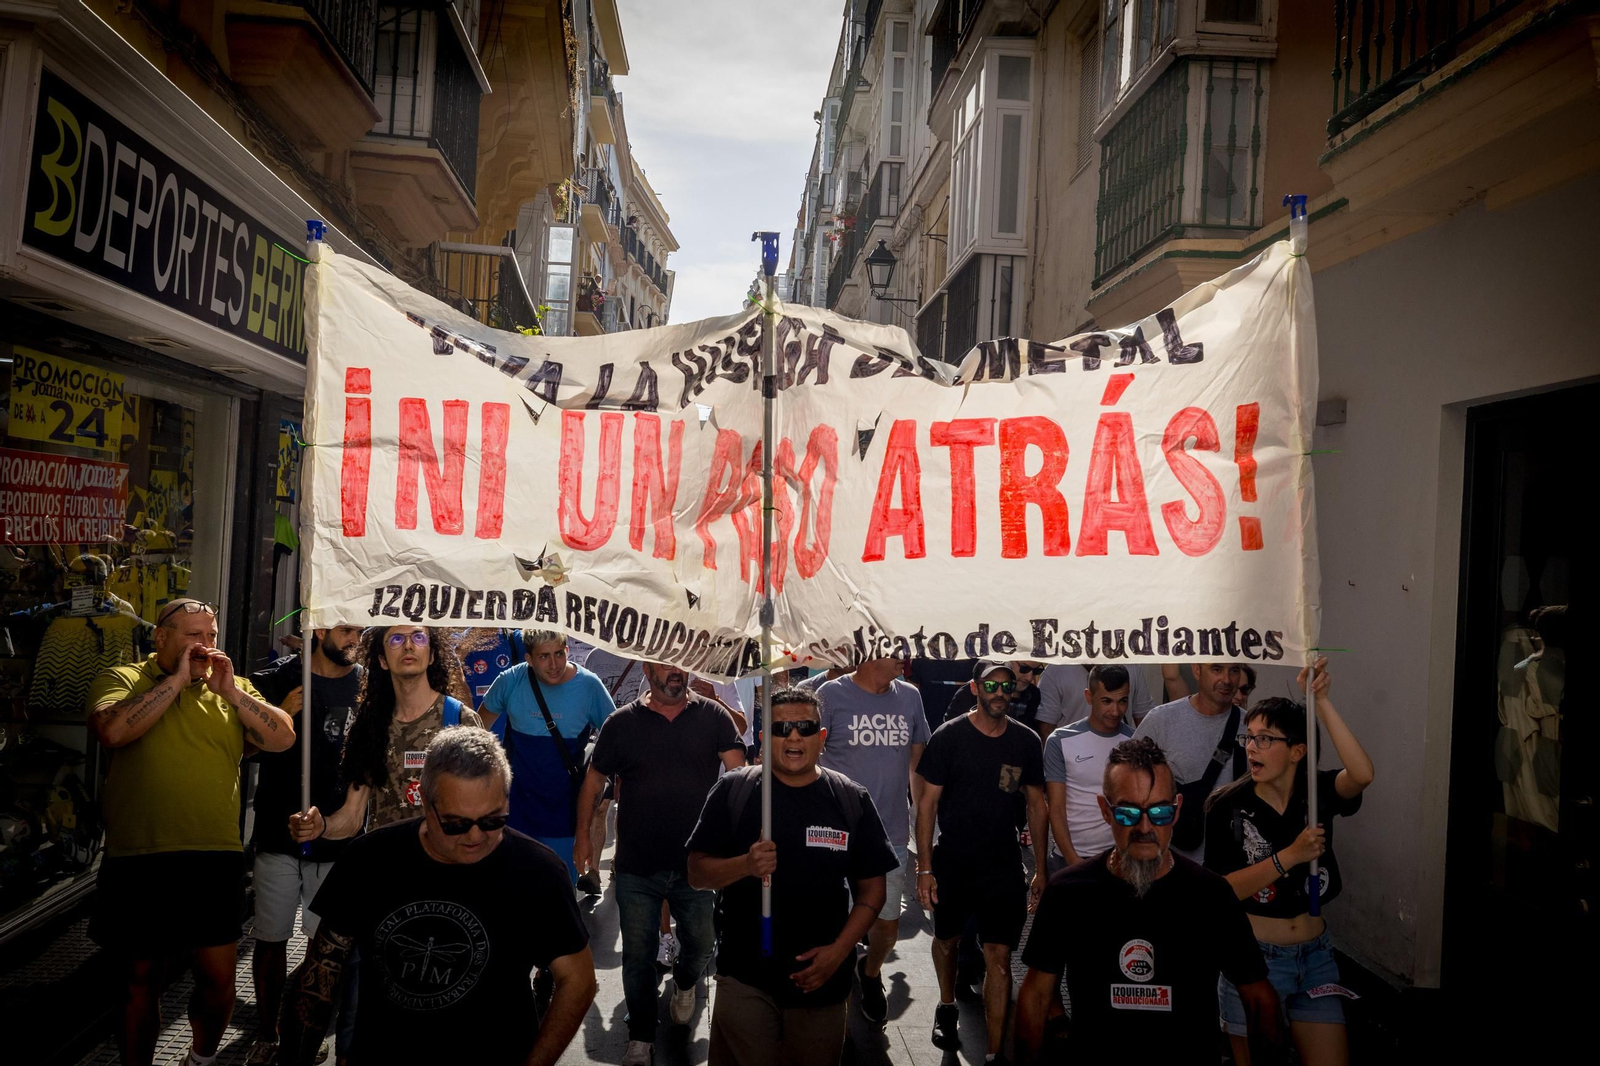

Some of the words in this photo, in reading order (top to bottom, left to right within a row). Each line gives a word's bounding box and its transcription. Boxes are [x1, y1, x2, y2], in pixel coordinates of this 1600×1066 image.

[74, 121, 250, 325] DEPORTES
[13, 353, 125, 401] PROMOCIÓN
[31, 381, 63, 399] Joma
[49, 400, 109, 447] 24
[0, 457, 78, 490] ROMOCIÓN
[77, 463, 117, 491] Joma
[559, 409, 686, 561] UN
[860, 373, 1265, 564] ATRÁS!
[63, 490, 101, 518] FÚTBOL
[103, 498, 126, 519] SALA
[4, 515, 60, 542] PRECIOS
[368, 583, 559, 624] IZQUIERDA
[964, 623, 1018, 659] de
[1029, 615, 1284, 661] Estudiantes
[848, 730, 910, 747] JONES
[808, 830, 841, 840] IZQUIERDA
[404, 902, 482, 938] PLATAFORMA
[1113, 986, 1158, 998] IZQUIERDA
[1113, 997, 1169, 1006] REVOLUCIONARIA
